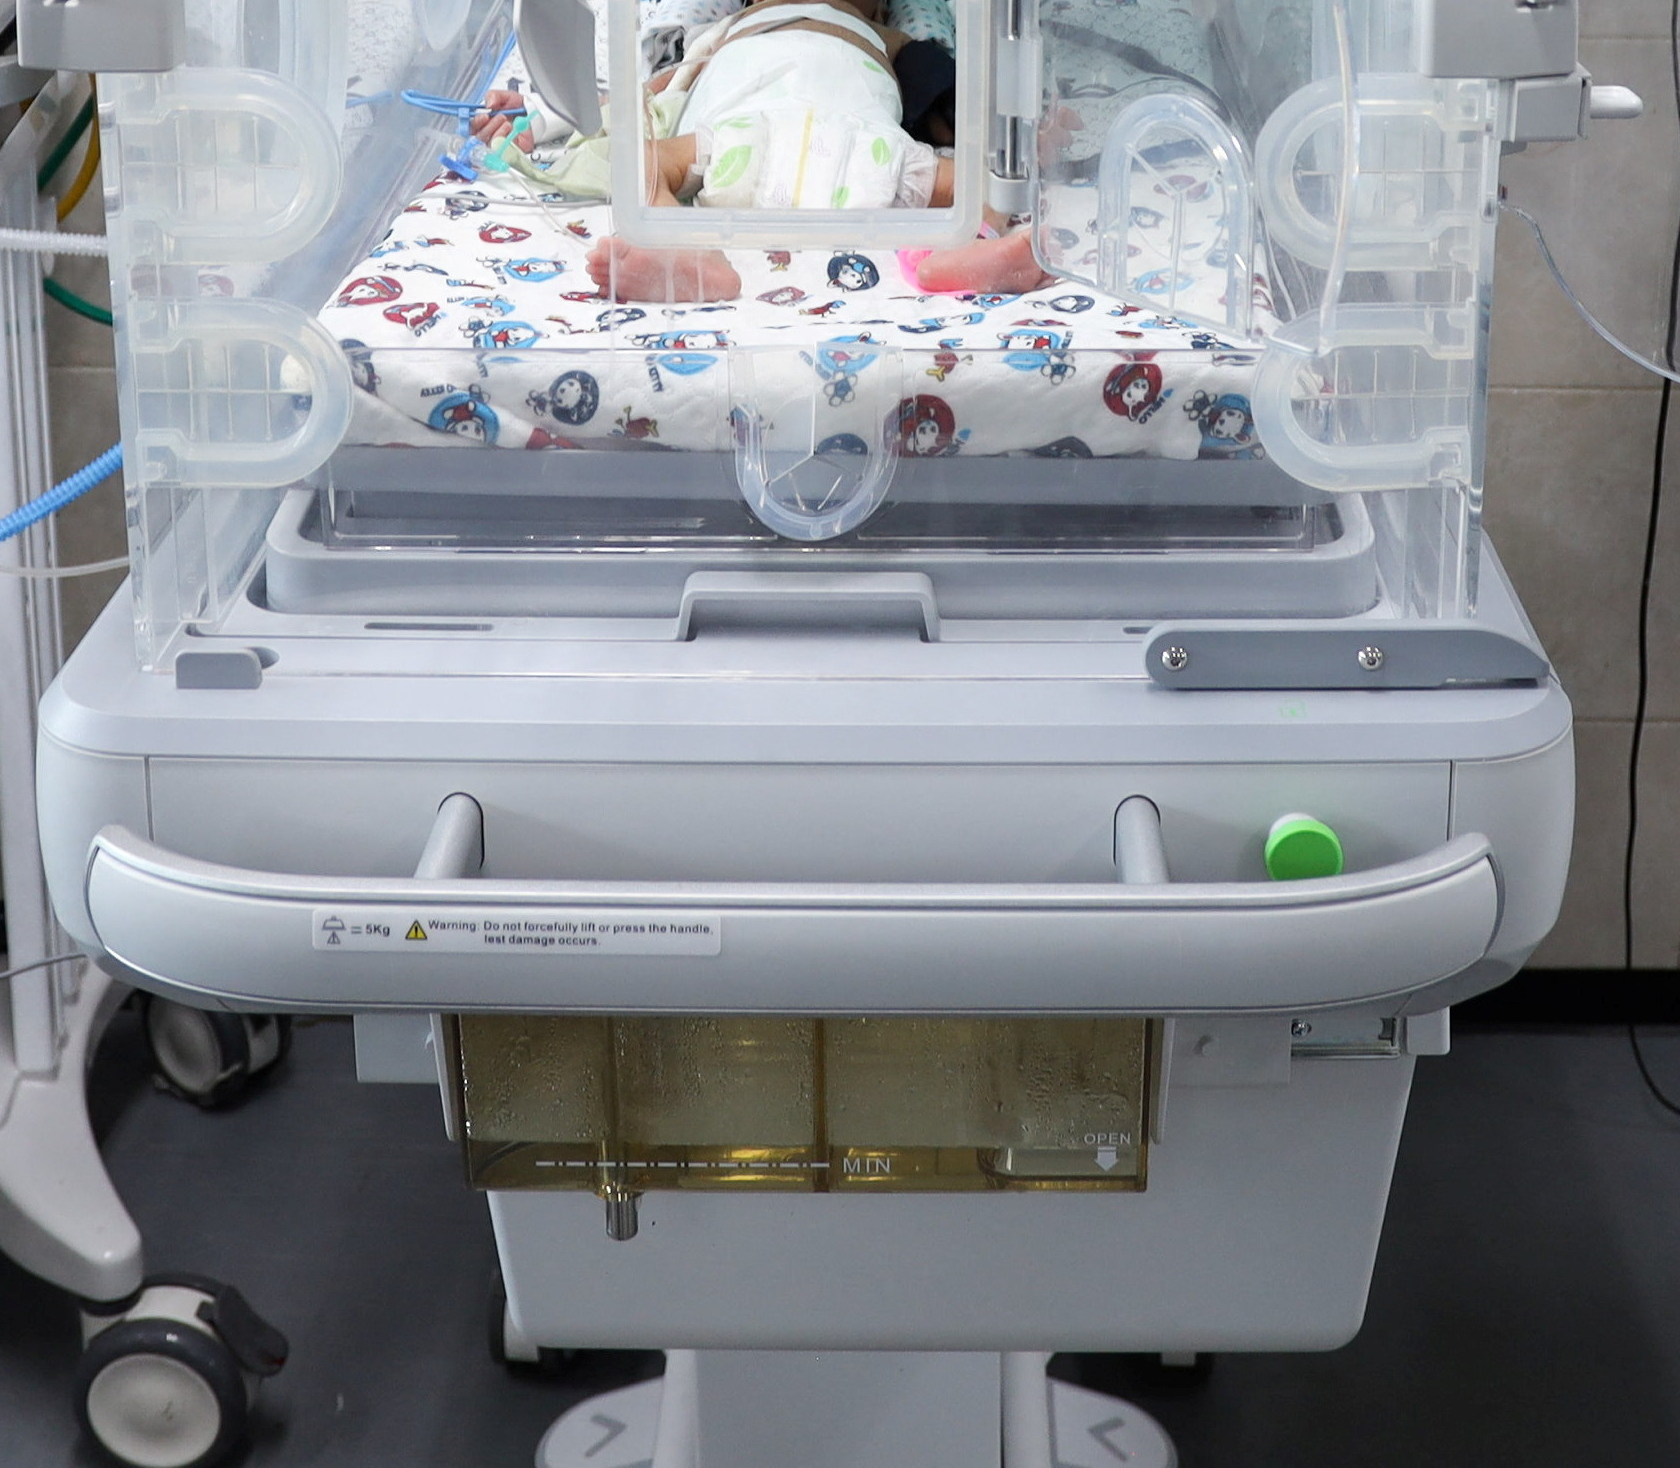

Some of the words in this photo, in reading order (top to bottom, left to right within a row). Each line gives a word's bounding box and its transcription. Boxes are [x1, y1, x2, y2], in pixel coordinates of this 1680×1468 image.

[366, 923, 391, 937] 5Kg
[428, 920, 480, 932] Warning:
[483, 921, 498, 931] Do
[502, 921, 521, 931] not
[523, 921, 578, 934] forcefully
[580, 922, 596, 932] lift
[612, 924, 645, 935] press
[648, 923, 666, 933] the
[669, 923, 714, 935] handle,
[484, 935, 505, 945] lest
[507, 935, 555, 947] damage
[558, 936, 601, 946] occurs.
[1084, 1132, 1131, 1145] OPEN
[843, 1157, 891, 1173] MIN
